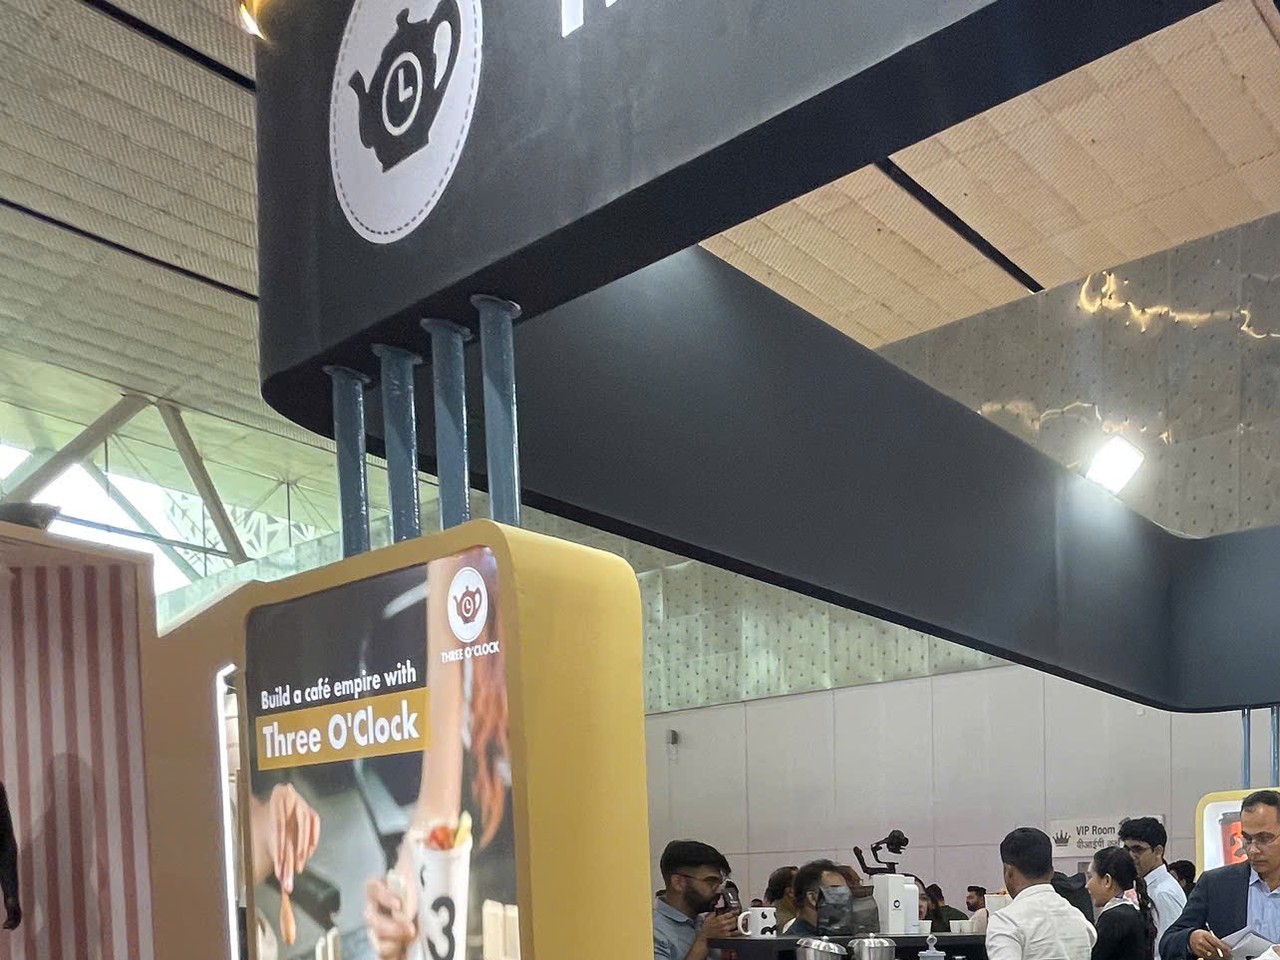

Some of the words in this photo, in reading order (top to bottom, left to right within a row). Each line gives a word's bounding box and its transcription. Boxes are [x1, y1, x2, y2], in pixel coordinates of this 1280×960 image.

[441, 648, 464, 663] THREE
[261, 685, 290, 710] Build
[293, 689, 302, 703] a
[304, 677, 331, 702] café
[333, 669, 381, 699] empire
[383, 659, 417, 687] with
[262, 721, 322, 758] Three
[327, 699, 420, 750] O'Clock
[1076, 825, 1090, 835] VIP
[1092, 825, 1116, 835] Room
